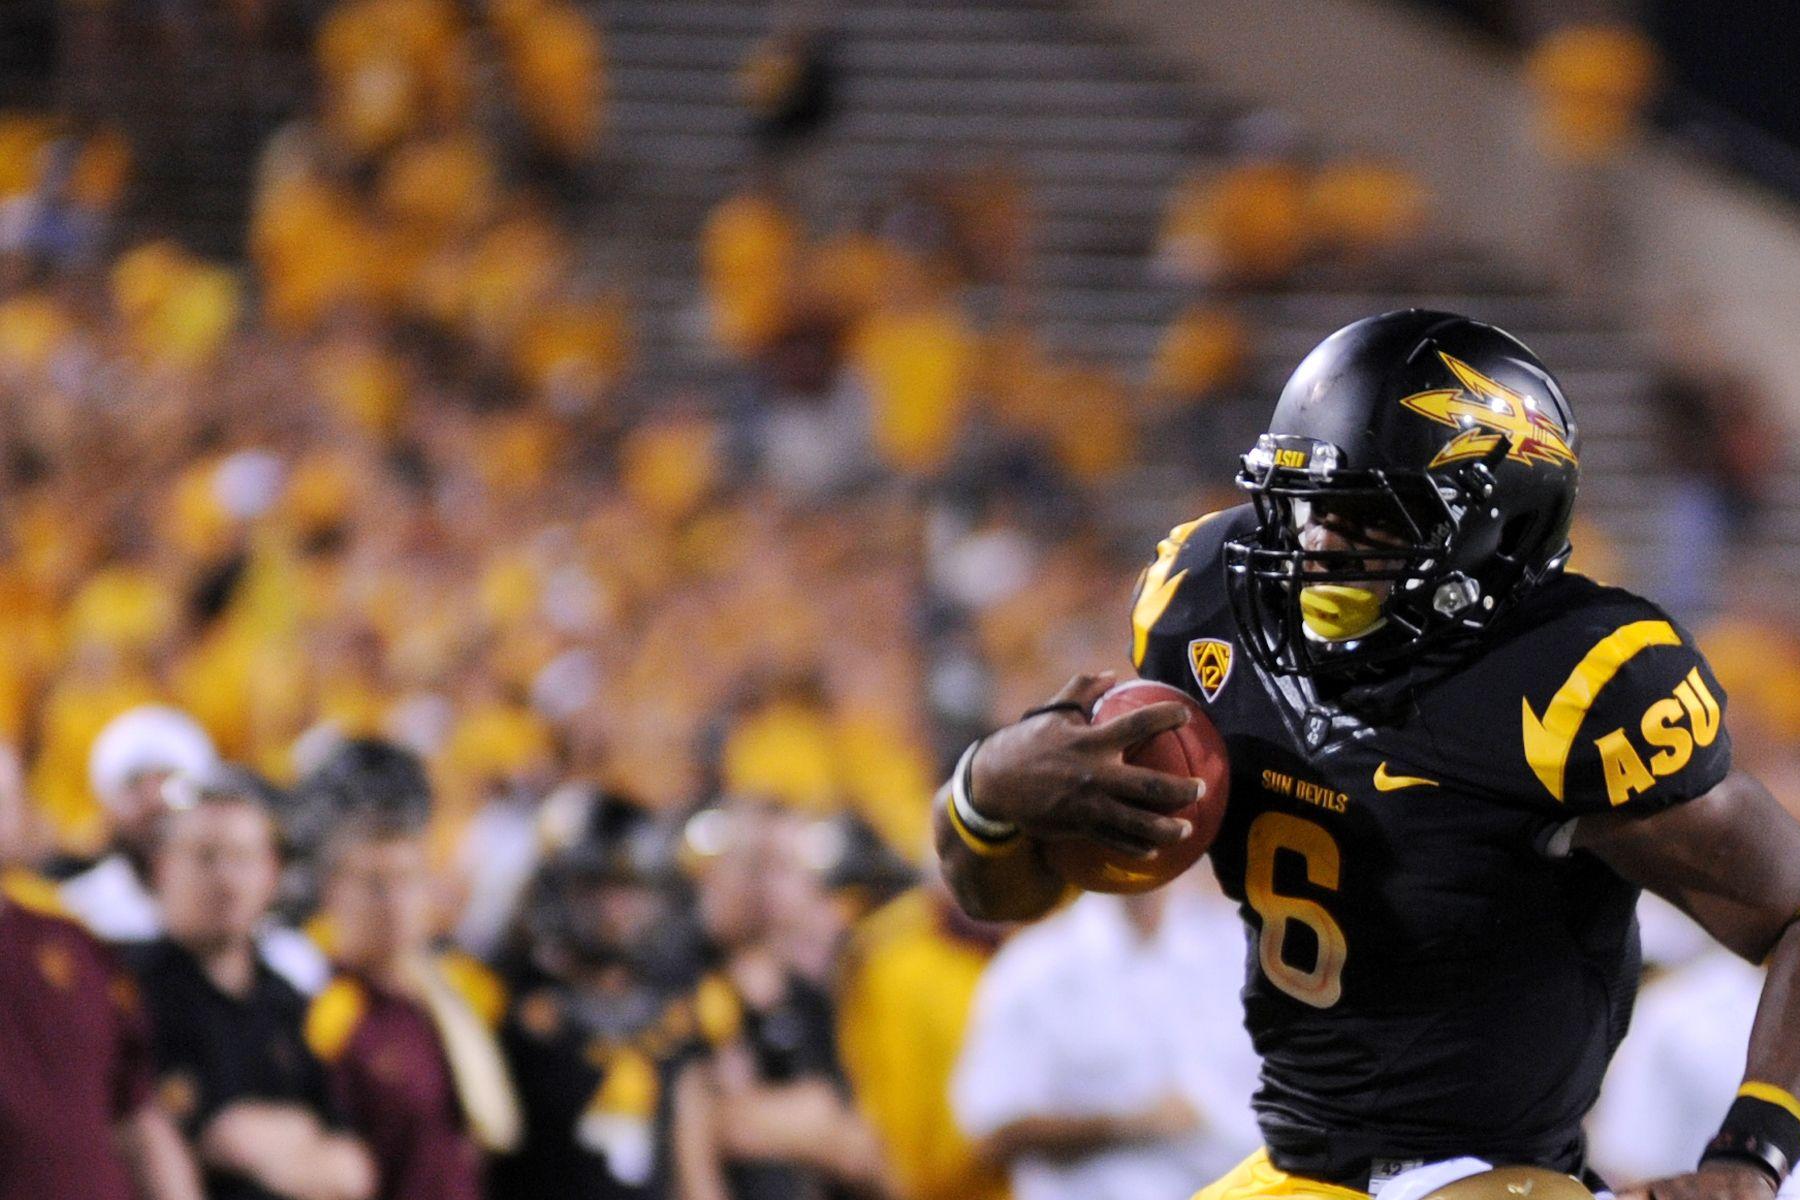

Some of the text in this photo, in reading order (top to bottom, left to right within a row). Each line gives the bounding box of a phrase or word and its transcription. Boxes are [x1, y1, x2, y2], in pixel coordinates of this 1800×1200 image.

[1274, 448, 1306, 468] ASU
[1202, 666, 1220, 688] 12
[1593, 666, 1721, 807] ASU
[1262, 769, 1349, 814] SUN DEVILS
[1245, 811, 1347, 1010] 6
